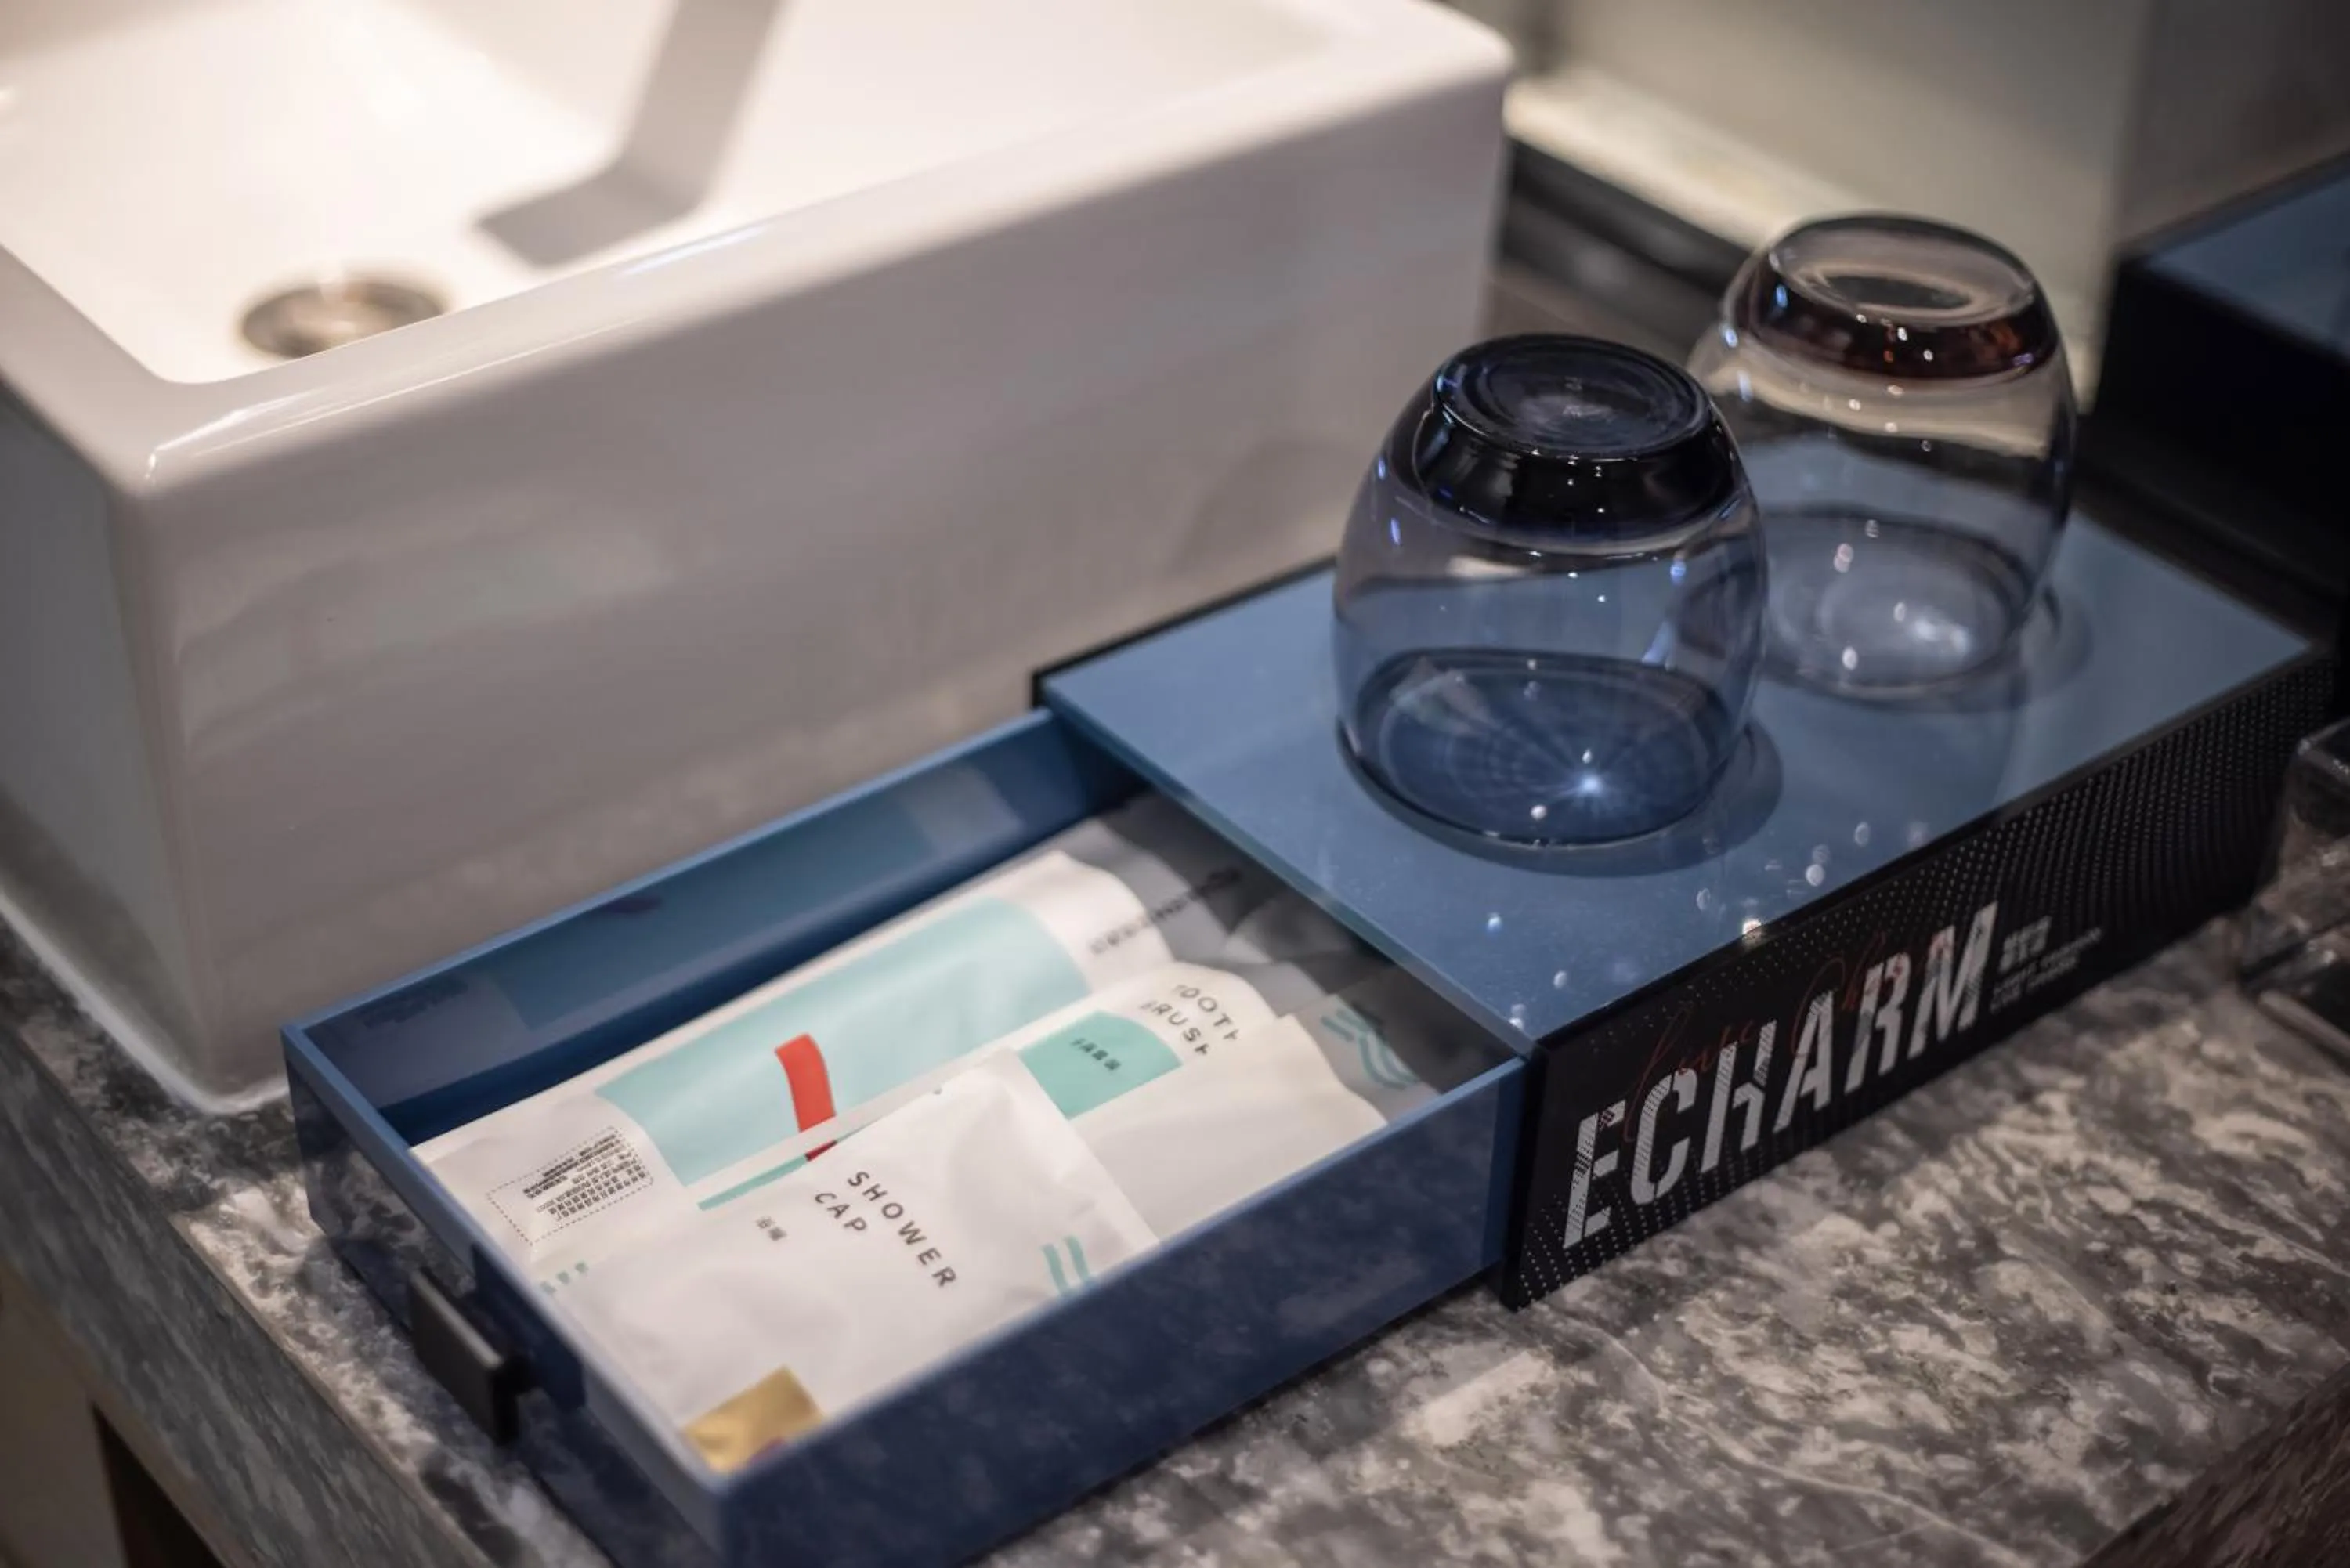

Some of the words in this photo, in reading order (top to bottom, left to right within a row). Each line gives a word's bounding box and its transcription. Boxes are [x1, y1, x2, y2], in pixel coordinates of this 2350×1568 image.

[1562, 901, 1998, 1248] ECHARM
[814, 1192, 868, 1231] CAP
[847, 1171, 957, 1287] SHOWER
